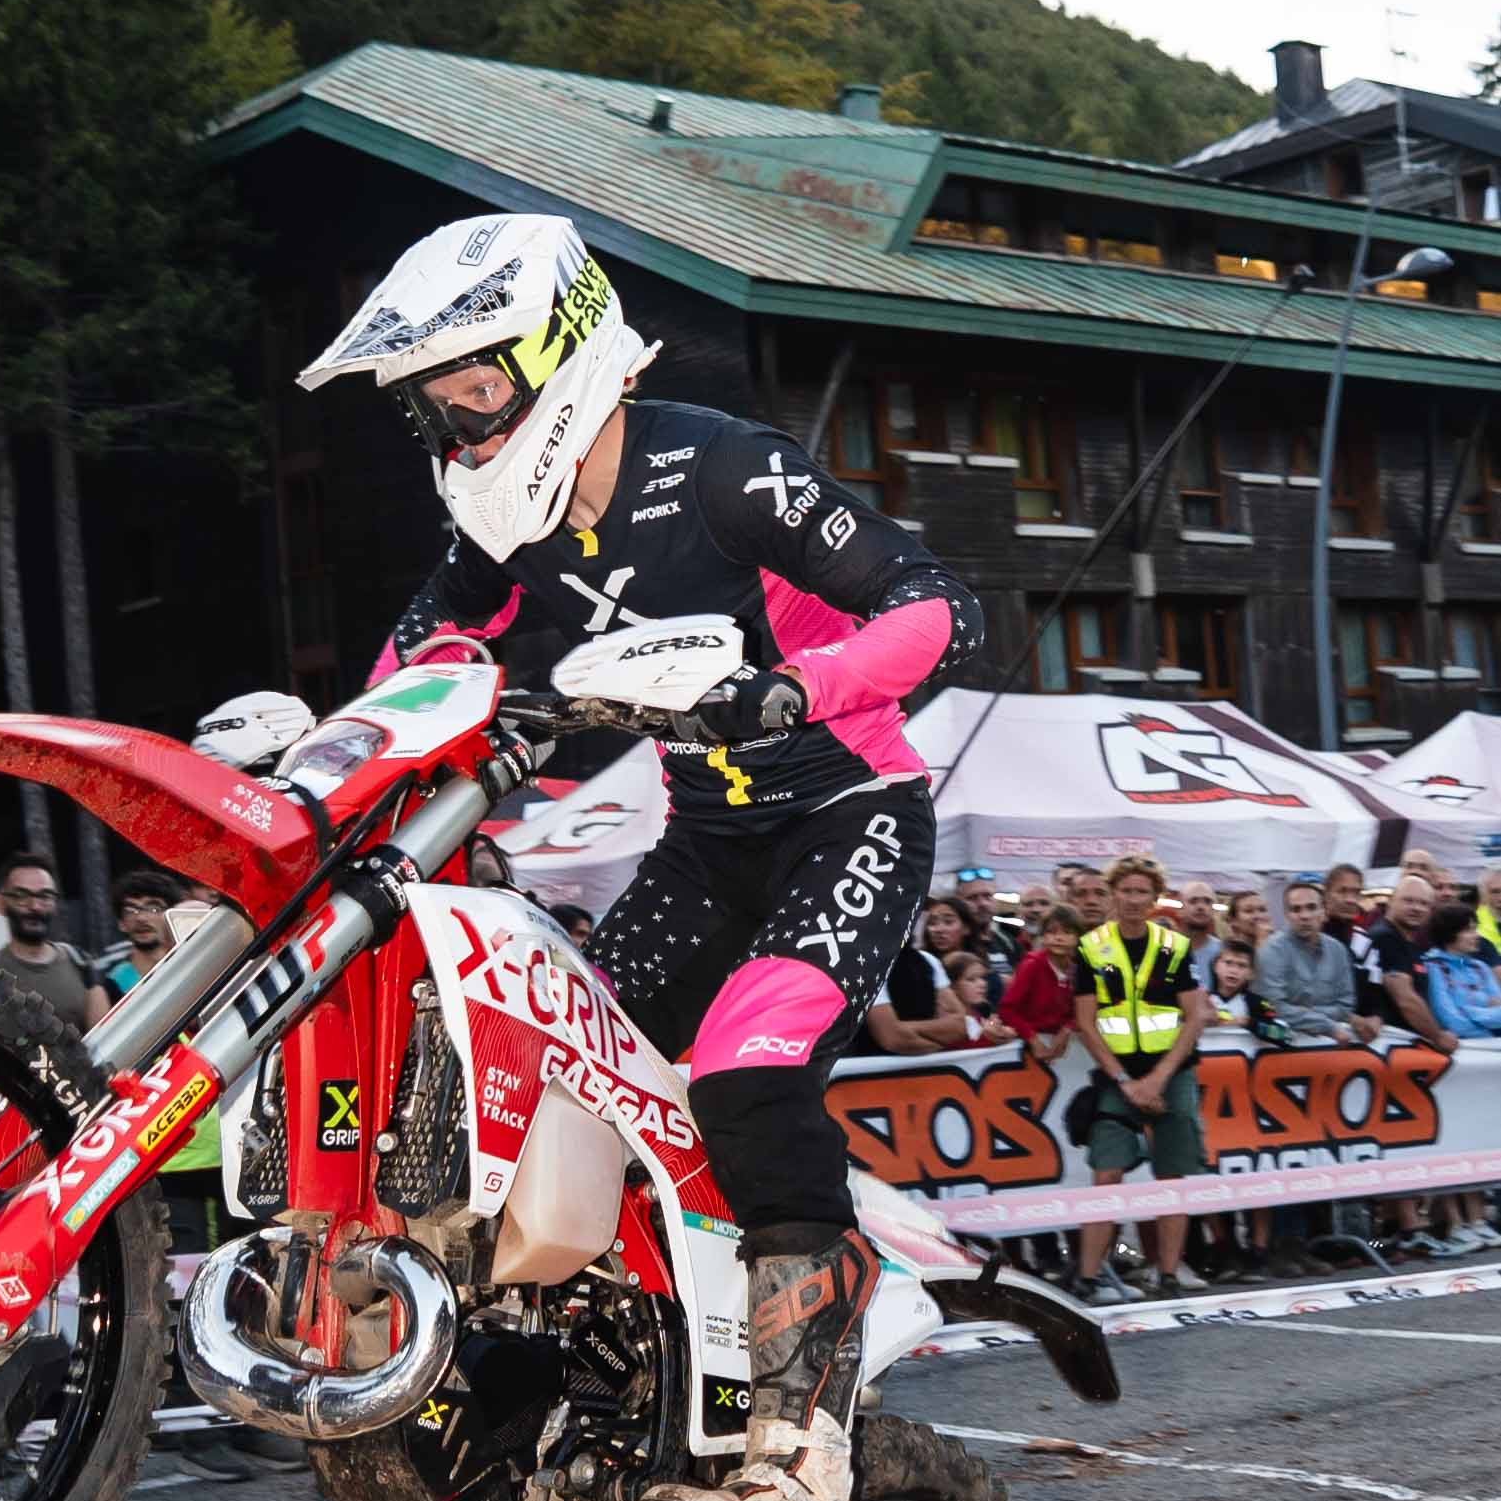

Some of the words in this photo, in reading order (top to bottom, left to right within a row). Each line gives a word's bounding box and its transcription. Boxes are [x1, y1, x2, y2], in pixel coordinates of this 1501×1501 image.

[527, 403, 573, 501] ACERBIS
[645, 446, 696, 468] XTRIG
[618, 634, 726, 662] ACERBIS
[220, 796, 272, 833] TRACK
[486, 1066, 522, 1091] STAY
[483, 1084, 506, 1104] ON
[539, 1043, 695, 1151] GASGAS
[146, 1078, 207, 1146] ACERBIS
[482, 1101, 527, 1131] TRACK
[322, 1129, 361, 1147] GRIP
[80, 1152, 137, 1212] MOTOREX
[248, 1194, 280, 1205] X-GRIP
[713, 1220, 744, 1238] MOTO
[585, 1331, 627, 1373] X-GRIP
